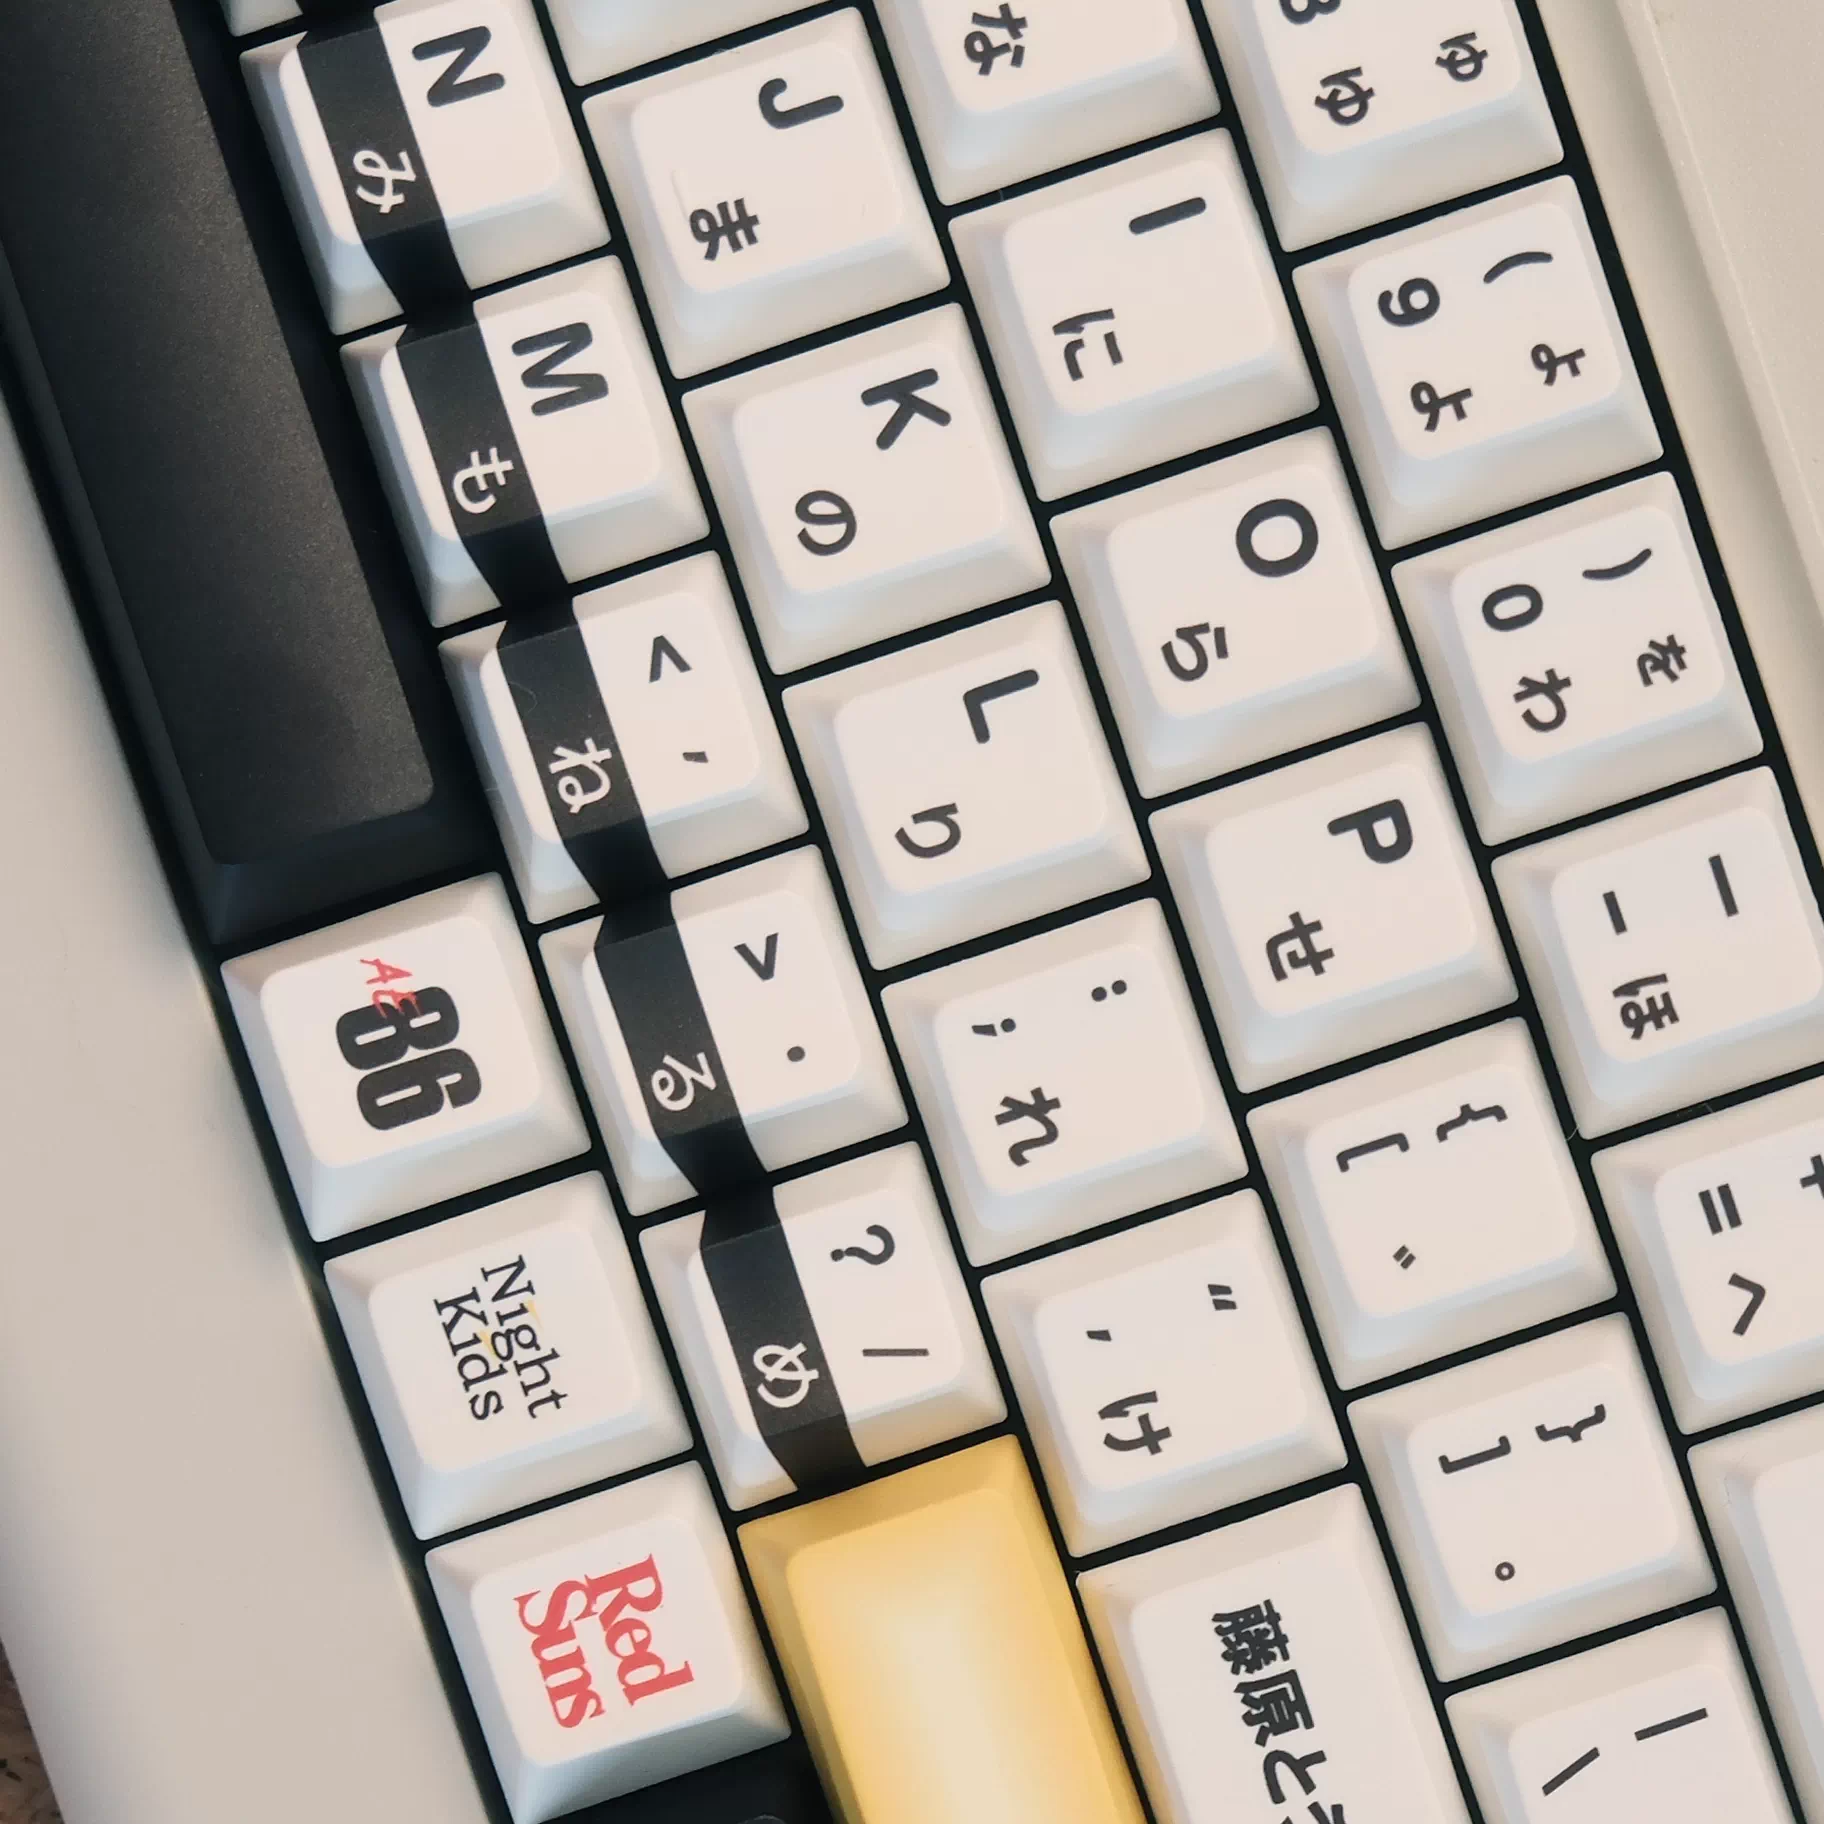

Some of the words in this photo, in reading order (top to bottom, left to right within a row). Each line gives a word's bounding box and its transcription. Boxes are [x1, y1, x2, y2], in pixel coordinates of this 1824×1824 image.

[411, 25, 505, 108] N
[963, 2, 1028, 76] な
[758, 77, 845, 130] J
[352, 149, 417, 214] み
[688, 197, 760, 261] ま
[511, 321, 609, 417] M
[1051, 307, 1123, 382] に
[1377, 277, 1441, 327] 9
[1410, 381, 1473, 433] よ
[860, 368, 952, 451] K
[452, 447, 514, 514] も
[794, 489, 857, 557] の
[1235, 498, 1319, 578] O
[1160, 621, 1229, 682] ら
[1636, 634, 1688, 687] を
[962, 669, 1040, 744] L
[1512, 667, 1572, 733] わ
[548, 737, 613, 814] ね
[894, 802, 962, 859] り
[1326, 798, 1414, 864] P
[1265, 911, 1335, 982] せ
[1612, 973, 1680, 1041] ほ
[651, 1052, 717, 1111] る
[994, 1086, 1061, 1167] れ
[830, 1224, 896, 1266] ?
[433, 1286, 508, 1421] Kids
[480, 1254, 568, 1421] Night
[753, 1342, 820, 1408] め
[1097, 1390, 1173, 1456] け
[513, 1579, 606, 1729] Suns
[583, 1553, 695, 1707] Red
